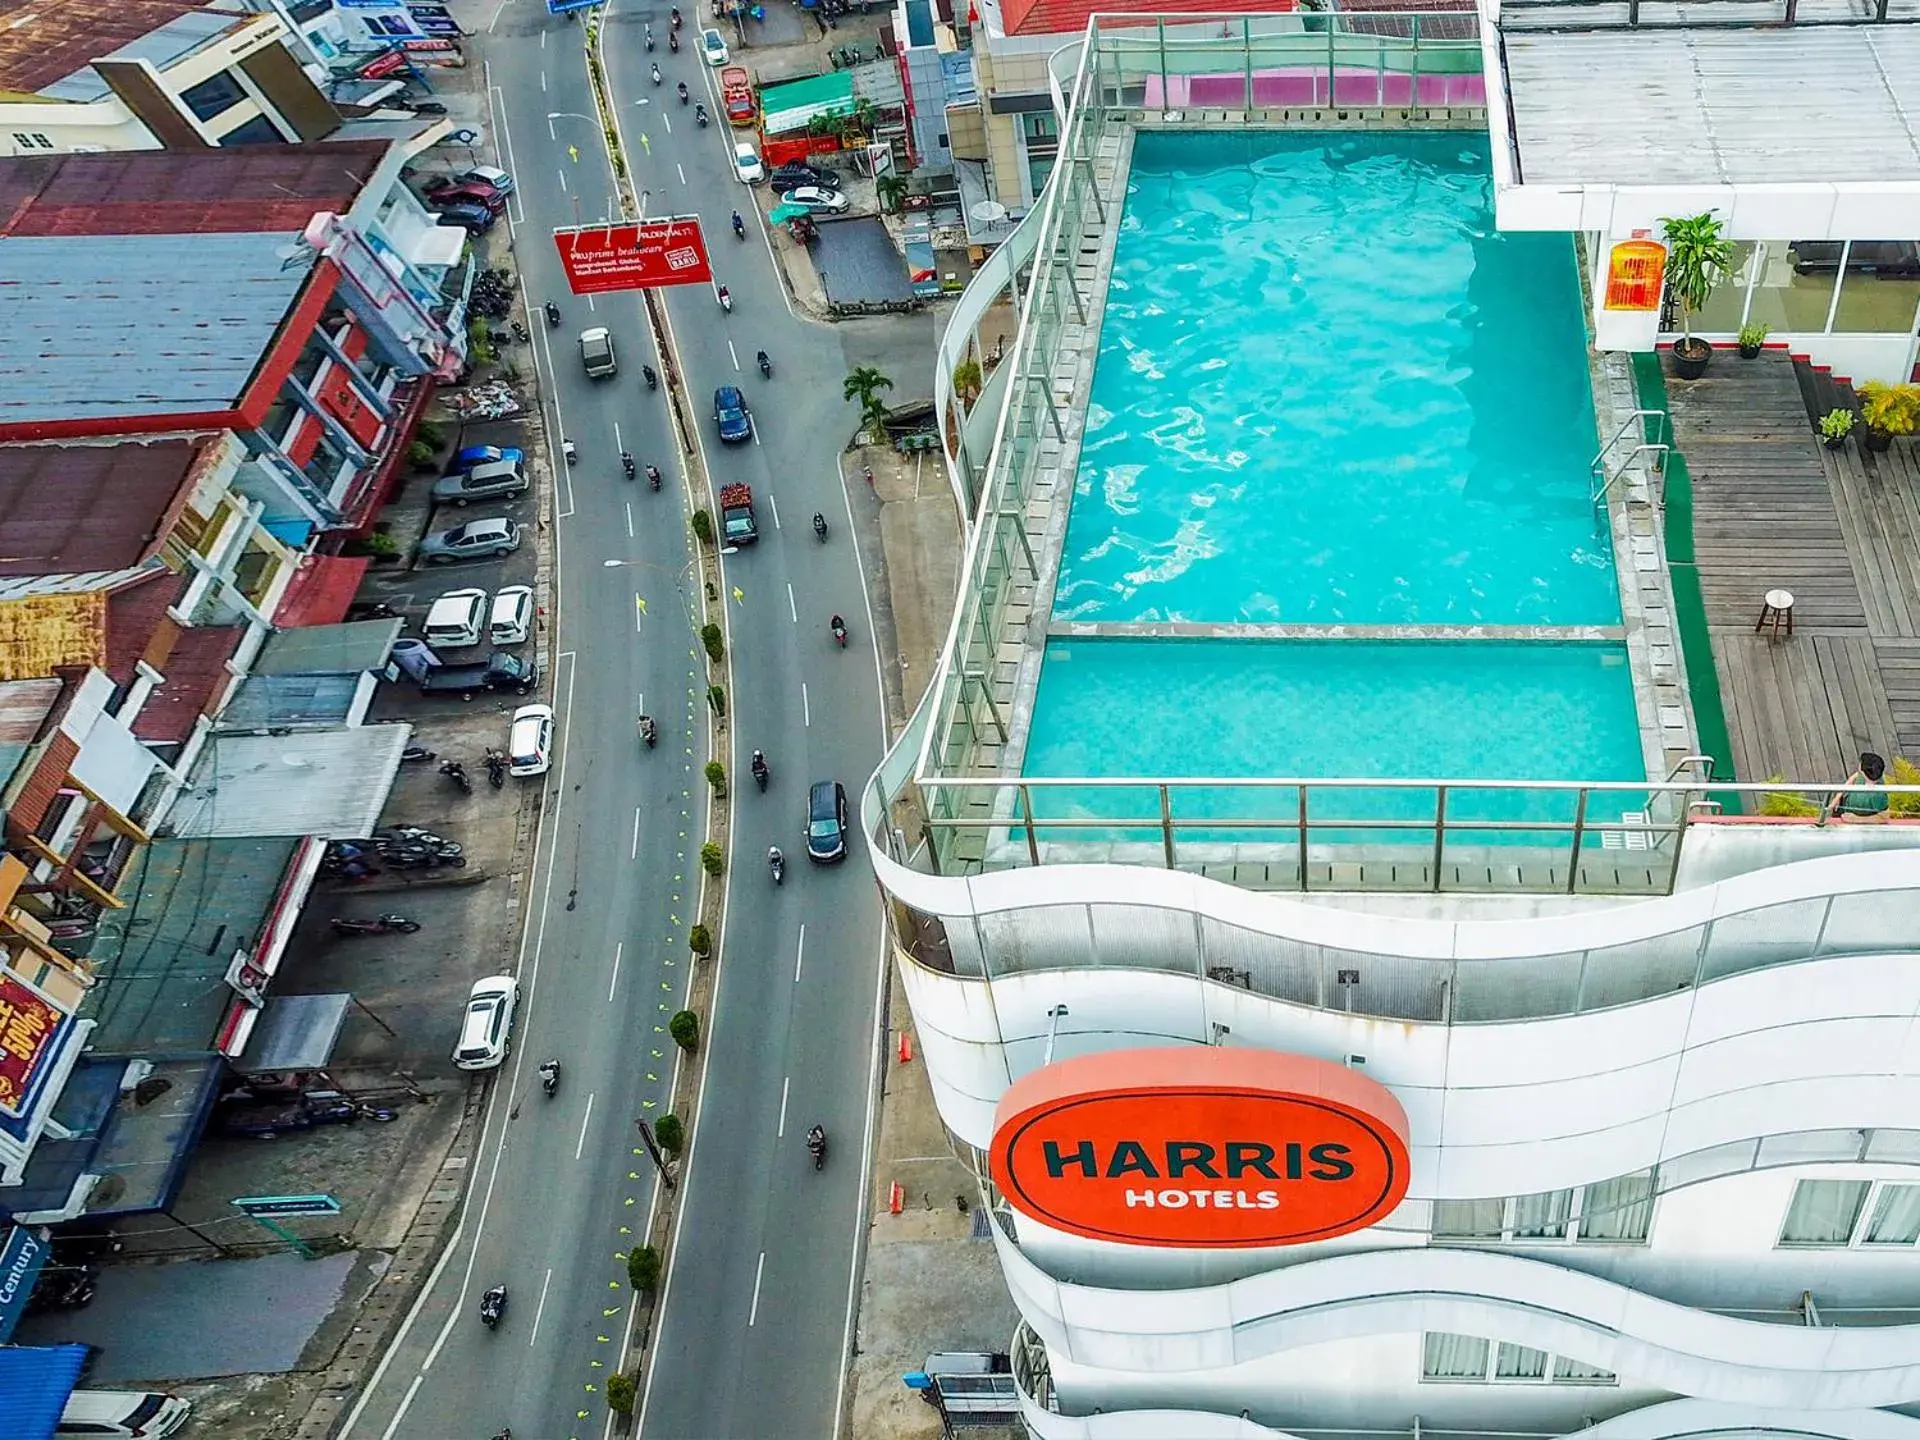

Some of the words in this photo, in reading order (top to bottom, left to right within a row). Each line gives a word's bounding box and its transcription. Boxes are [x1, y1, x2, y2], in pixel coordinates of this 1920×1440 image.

[1, 1010, 46, 1061] 50%
[1042, 1140, 1355, 1181] HARRIS
[1125, 1188, 1281, 1210] HOTELS
[0, 1236, 39, 1304] Century
